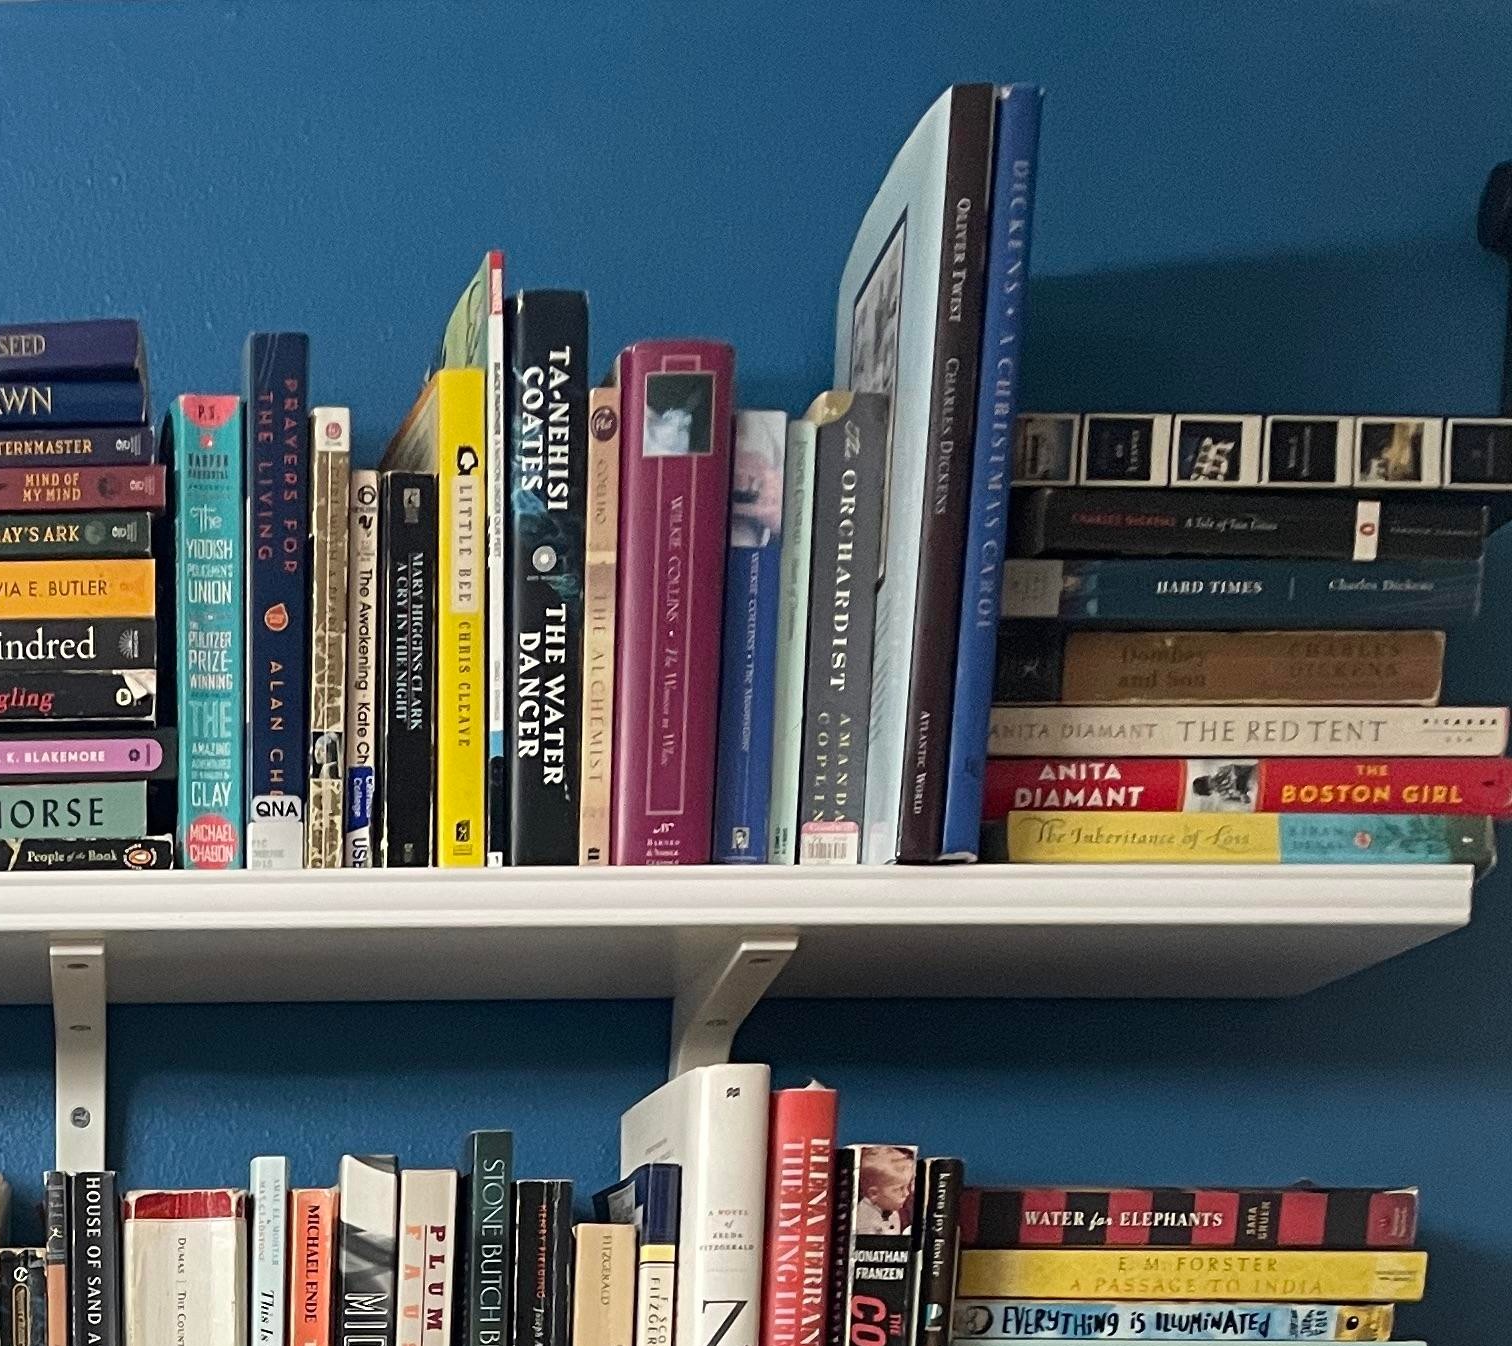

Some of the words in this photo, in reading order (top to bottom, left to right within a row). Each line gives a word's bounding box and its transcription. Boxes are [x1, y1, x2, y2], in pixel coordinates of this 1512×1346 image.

[521, 366, 545, 492] COATES
[44, 525, 80, 542] ARK
[544, 603, 567, 658] THE
[517, 632, 541, 759] DANCER
[542, 667, 566, 786] WATER
[1039, 763, 1122, 781] ANITA
[1014, 788, 1145, 808] DIAMANT
[255, 801, 299, 818] QNA
[482, 1159, 506, 1236] STONE
[1024, 1211, 1085, 1227] WATER
[1089, 1211, 1113, 1230] for
[1119, 1211, 1224, 1228] ELEPHANTS
[853, 1250, 908, 1264] JONATHAN
[479, 1244, 504, 1322] BUTCH
[855, 1267, 904, 1281] FRANZEN
